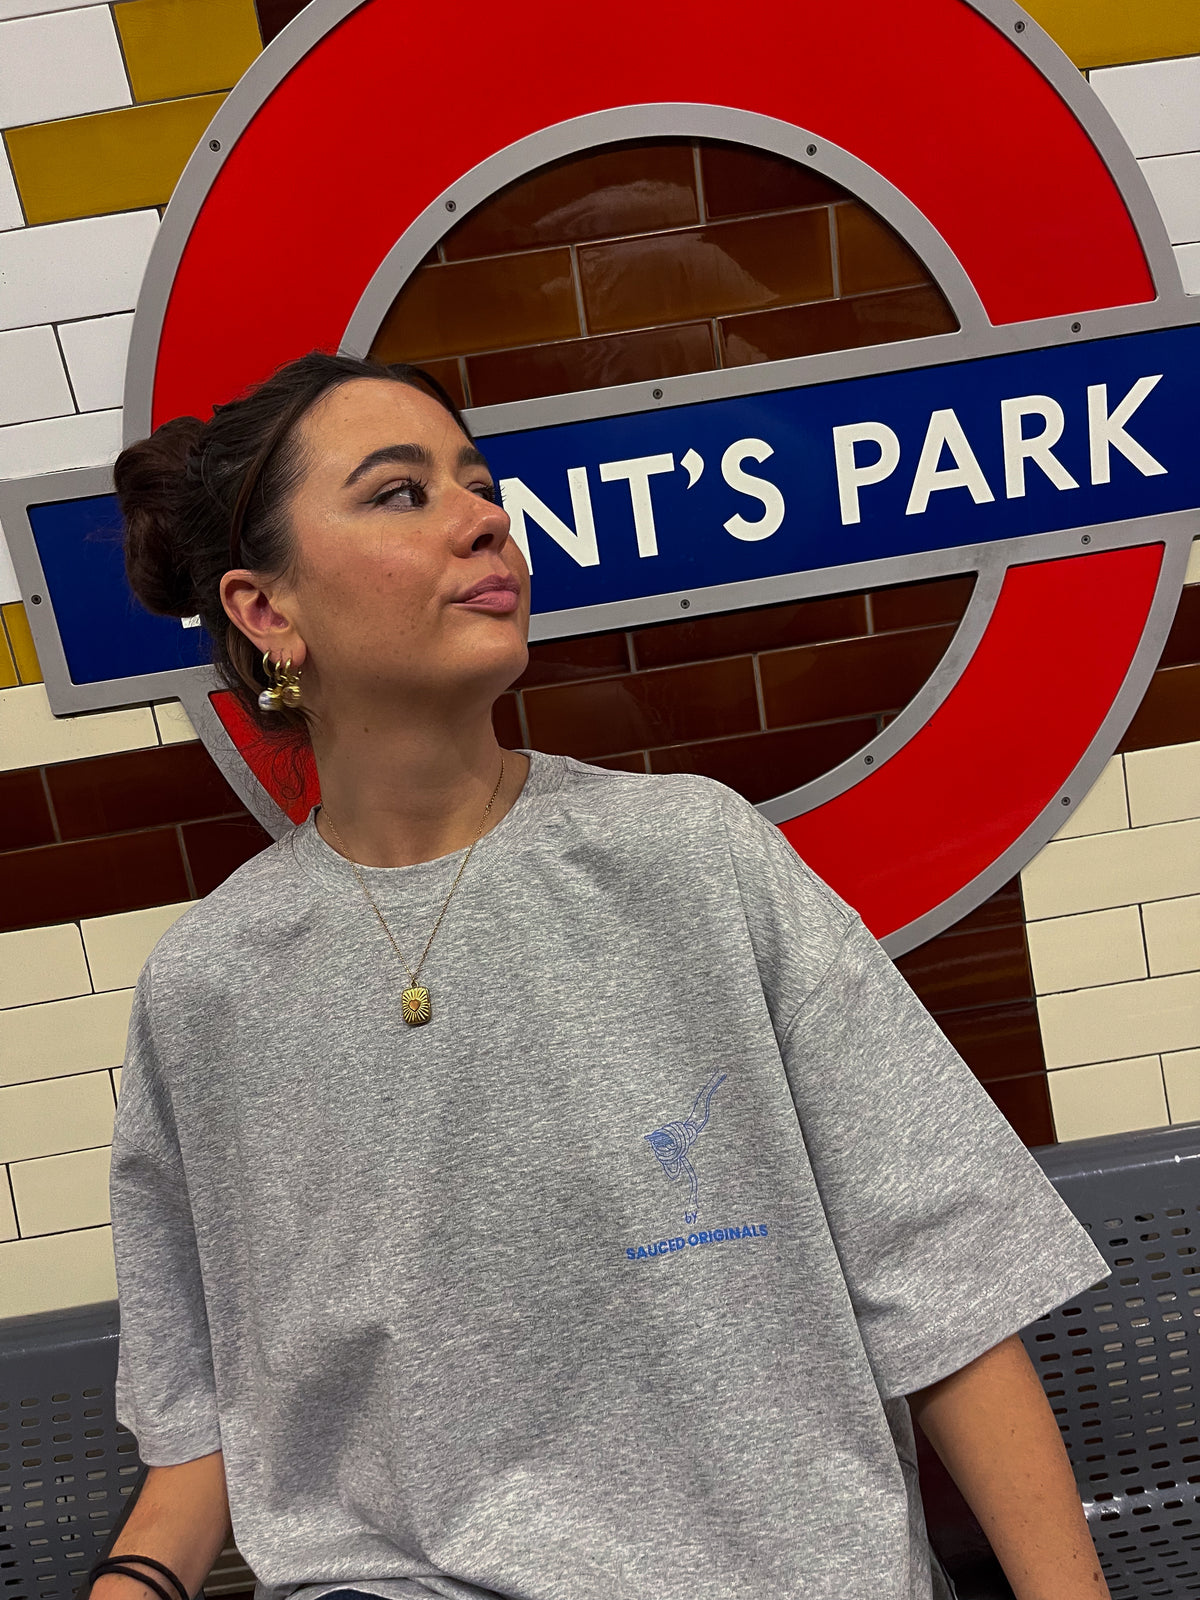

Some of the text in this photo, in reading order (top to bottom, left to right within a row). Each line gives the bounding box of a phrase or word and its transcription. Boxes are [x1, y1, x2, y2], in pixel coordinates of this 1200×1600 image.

[499, 374, 1168, 576] NT'S PARK
[626, 1224, 768, 1260] SAUCED ORIGINALS
